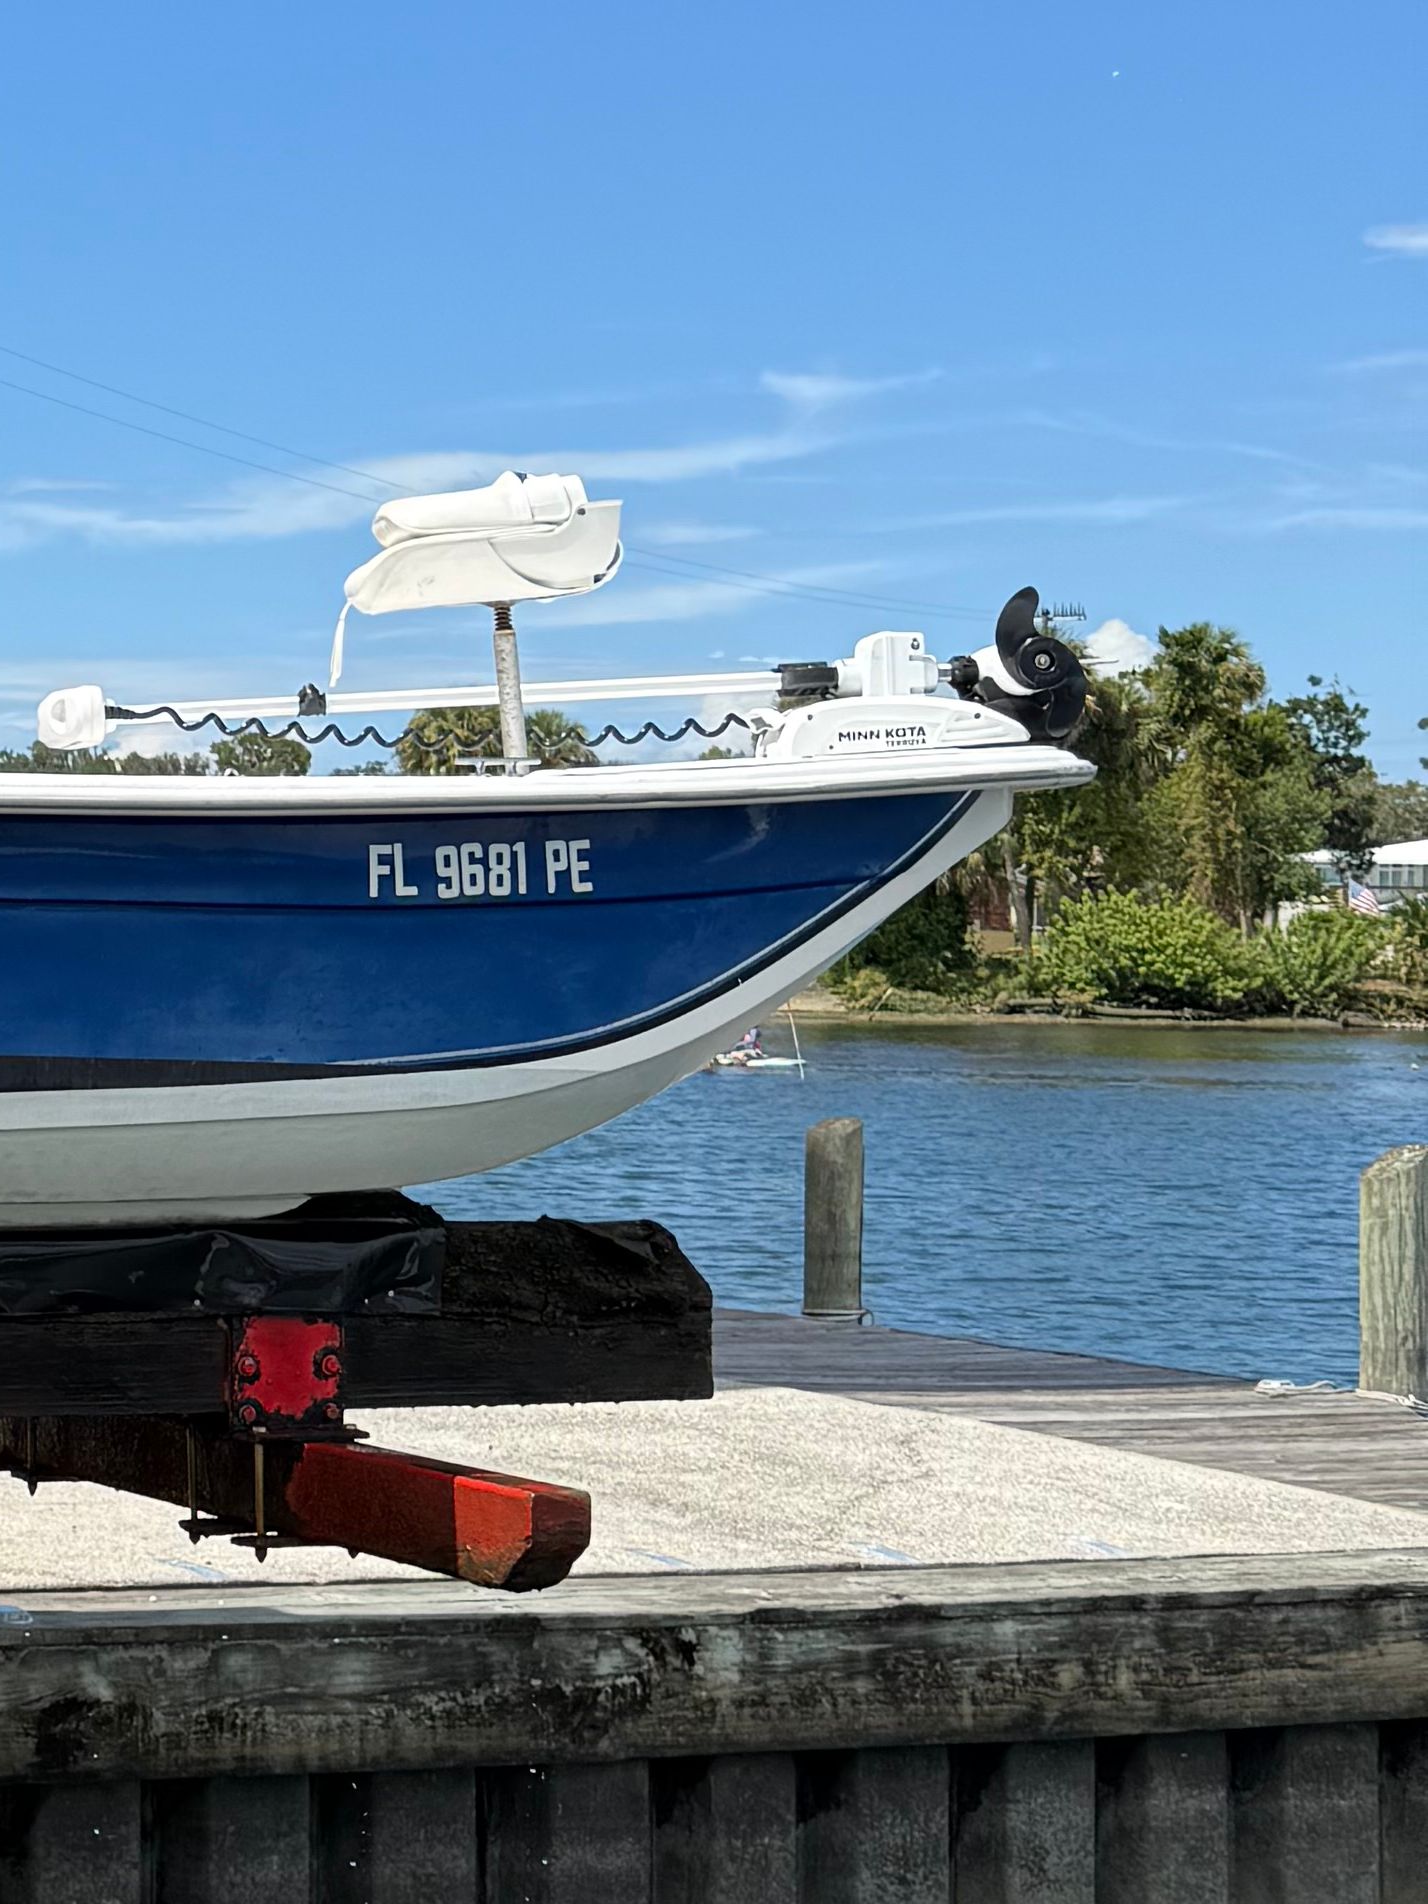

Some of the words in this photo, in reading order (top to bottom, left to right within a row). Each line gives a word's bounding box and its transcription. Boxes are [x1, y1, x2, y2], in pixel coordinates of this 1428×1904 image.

[838, 729, 881, 743] MINN
[885, 725, 927, 739] KOTA
[368, 842, 419, 898] FL
[434, 841, 528, 900] 9681
[545, 838, 594, 894] PE
